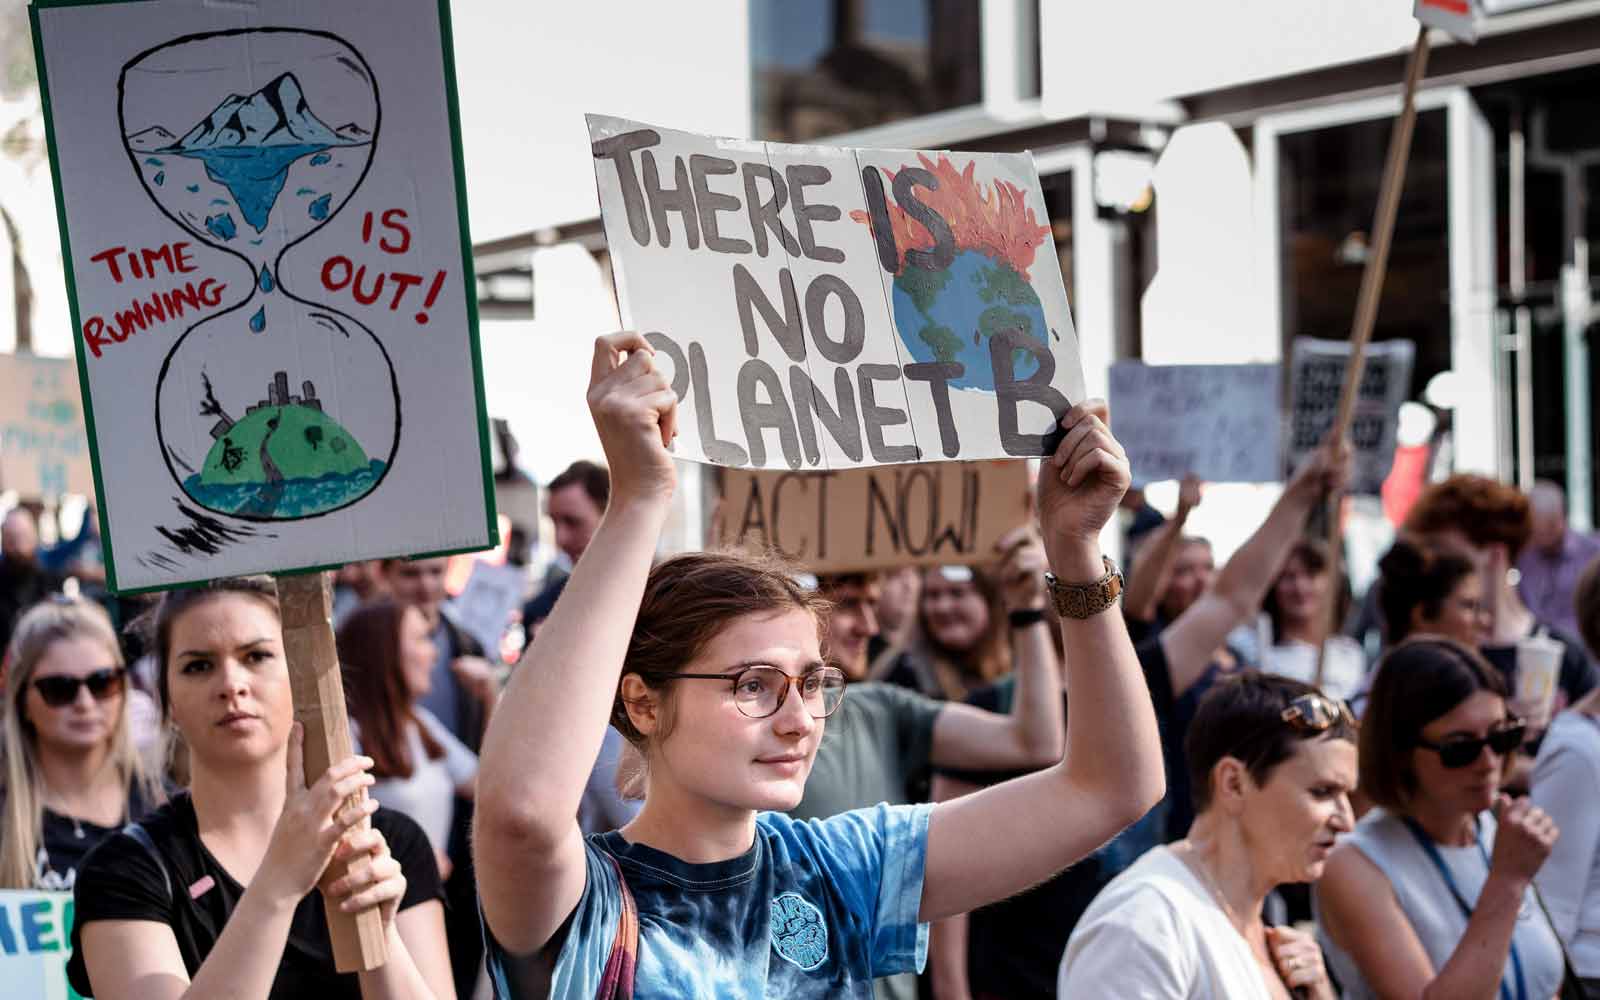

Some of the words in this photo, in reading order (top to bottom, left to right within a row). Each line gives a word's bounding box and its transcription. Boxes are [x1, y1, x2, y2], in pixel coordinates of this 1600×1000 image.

[362, 208, 411, 255] IS
[592, 128, 846, 264] THERE
[862, 164, 955, 274] IS
[90, 241, 196, 284] TIME
[320, 255, 447, 325] OUT!
[82, 276, 228, 358] RUNNING
[732, 263, 865, 364] NO
[989, 329, 1073, 457] B
[736, 469, 838, 558] ACT
